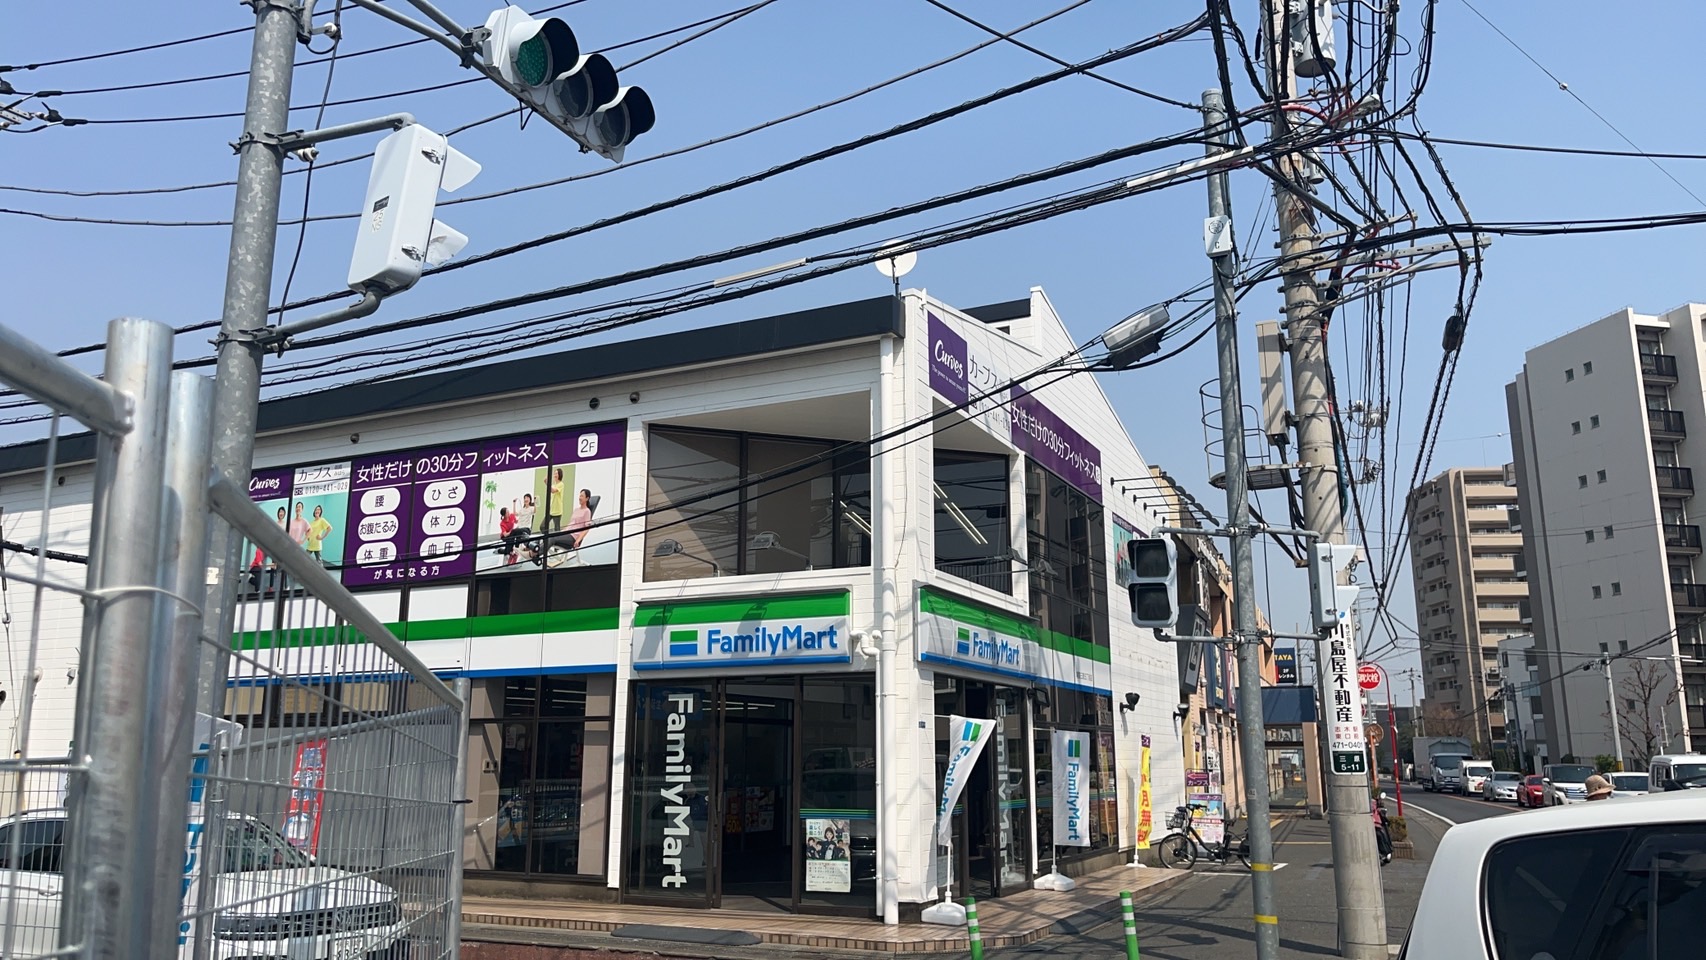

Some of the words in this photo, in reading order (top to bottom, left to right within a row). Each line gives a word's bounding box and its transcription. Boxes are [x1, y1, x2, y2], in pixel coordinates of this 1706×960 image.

[935, 339, 964, 380] Curves
[581, 438, 596, 453] 2F
[1012, 403, 1097, 479] 女性だけの30分フィットネス
[356, 442, 549, 484] 女性だけの30分フィットネス
[248, 476, 281, 492] Curves
[431, 486, 459, 501] ひざ
[374, 495, 385, 508] 腰
[359, 520, 397, 536] お腹たるみ
[430, 514, 457, 529] 体力
[363, 547, 389, 561] 体重
[427, 541, 455, 556] 血圧
[373, 565, 440, 580] が気になる方
[706, 624, 839, 656] FamilyMart
[973, 631, 1021, 665] FamilyMart
[1328, 623, 1353, 723] 川島屋不動産
[1341, 763, 1360, 771] 5-11
[660, 693, 694, 889] FamilyMart
[940, 745, 971, 815] FamilyM
[995, 698, 1010, 880] FamilyMart
[1067, 762, 1081, 842] FamilyMart
